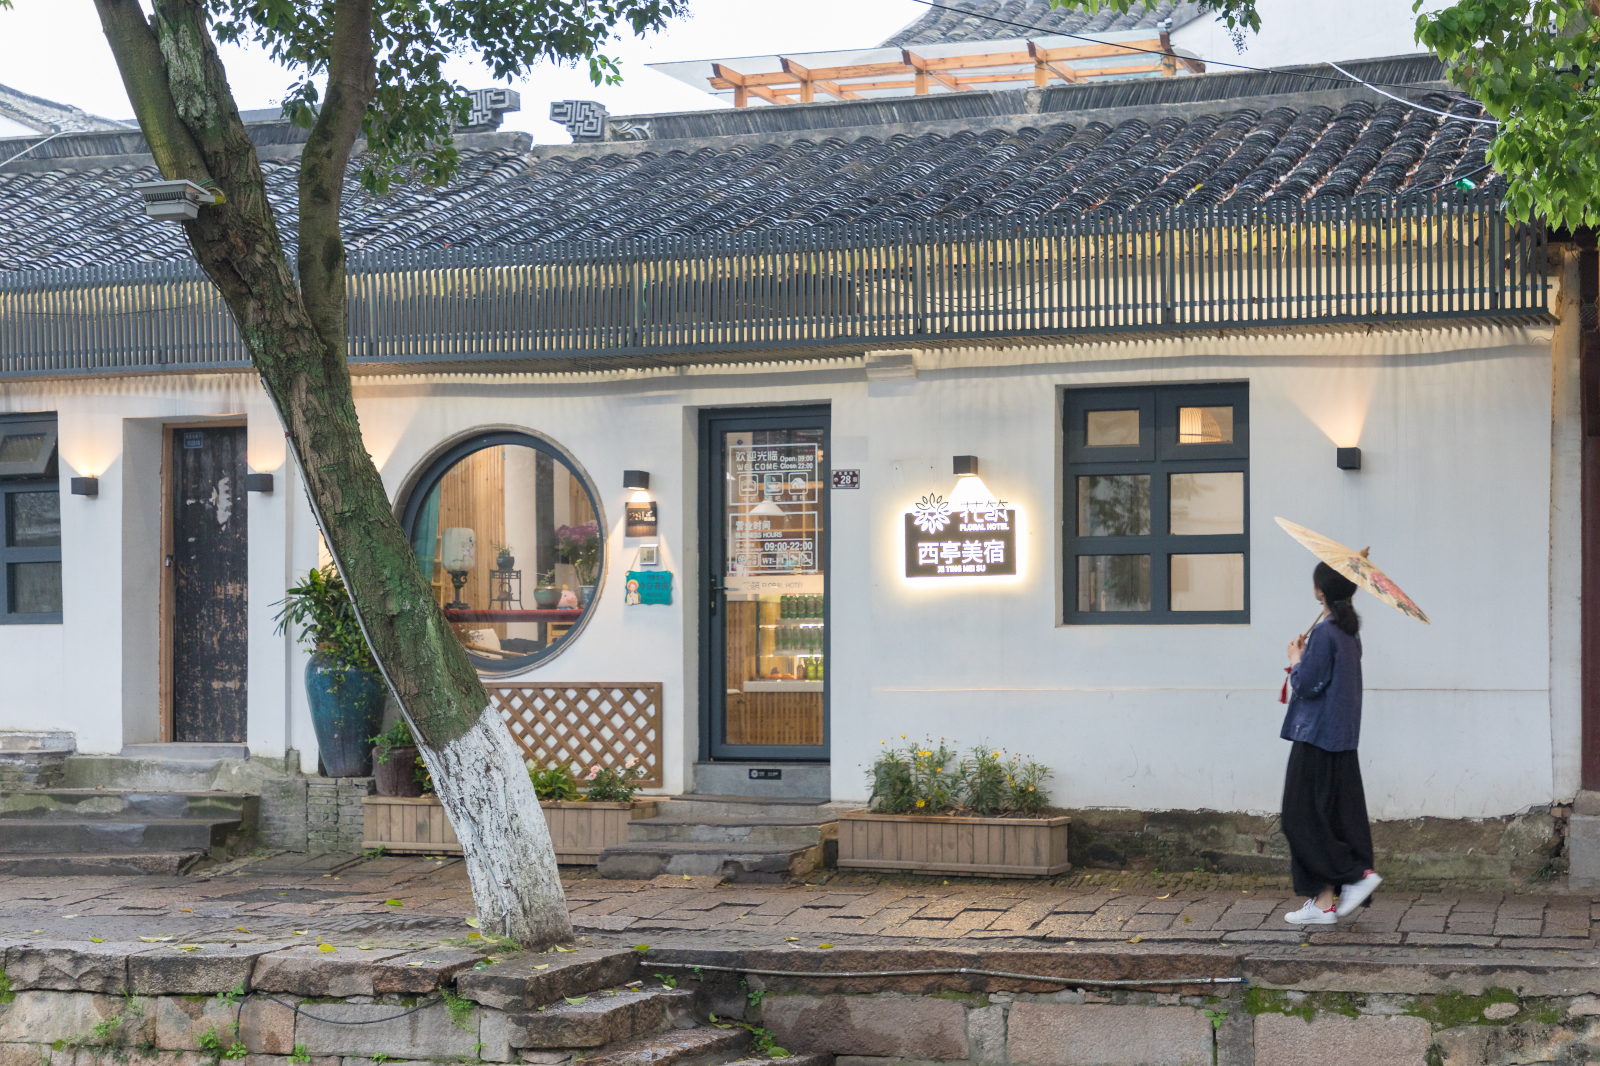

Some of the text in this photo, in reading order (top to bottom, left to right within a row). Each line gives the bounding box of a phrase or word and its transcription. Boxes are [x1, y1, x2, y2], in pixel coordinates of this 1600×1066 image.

[736, 451, 778, 462] 欢迎光临
[736, 463, 778, 471] WELCOME
[840, 475, 852, 484] 28
[735, 520, 771, 531] 营业时间
[959, 522, 1010, 532] FLORAL HOTEL
[764, 541, 813, 551] 09:00-22:00
[917, 539, 1005, 566] 西亭美宿
